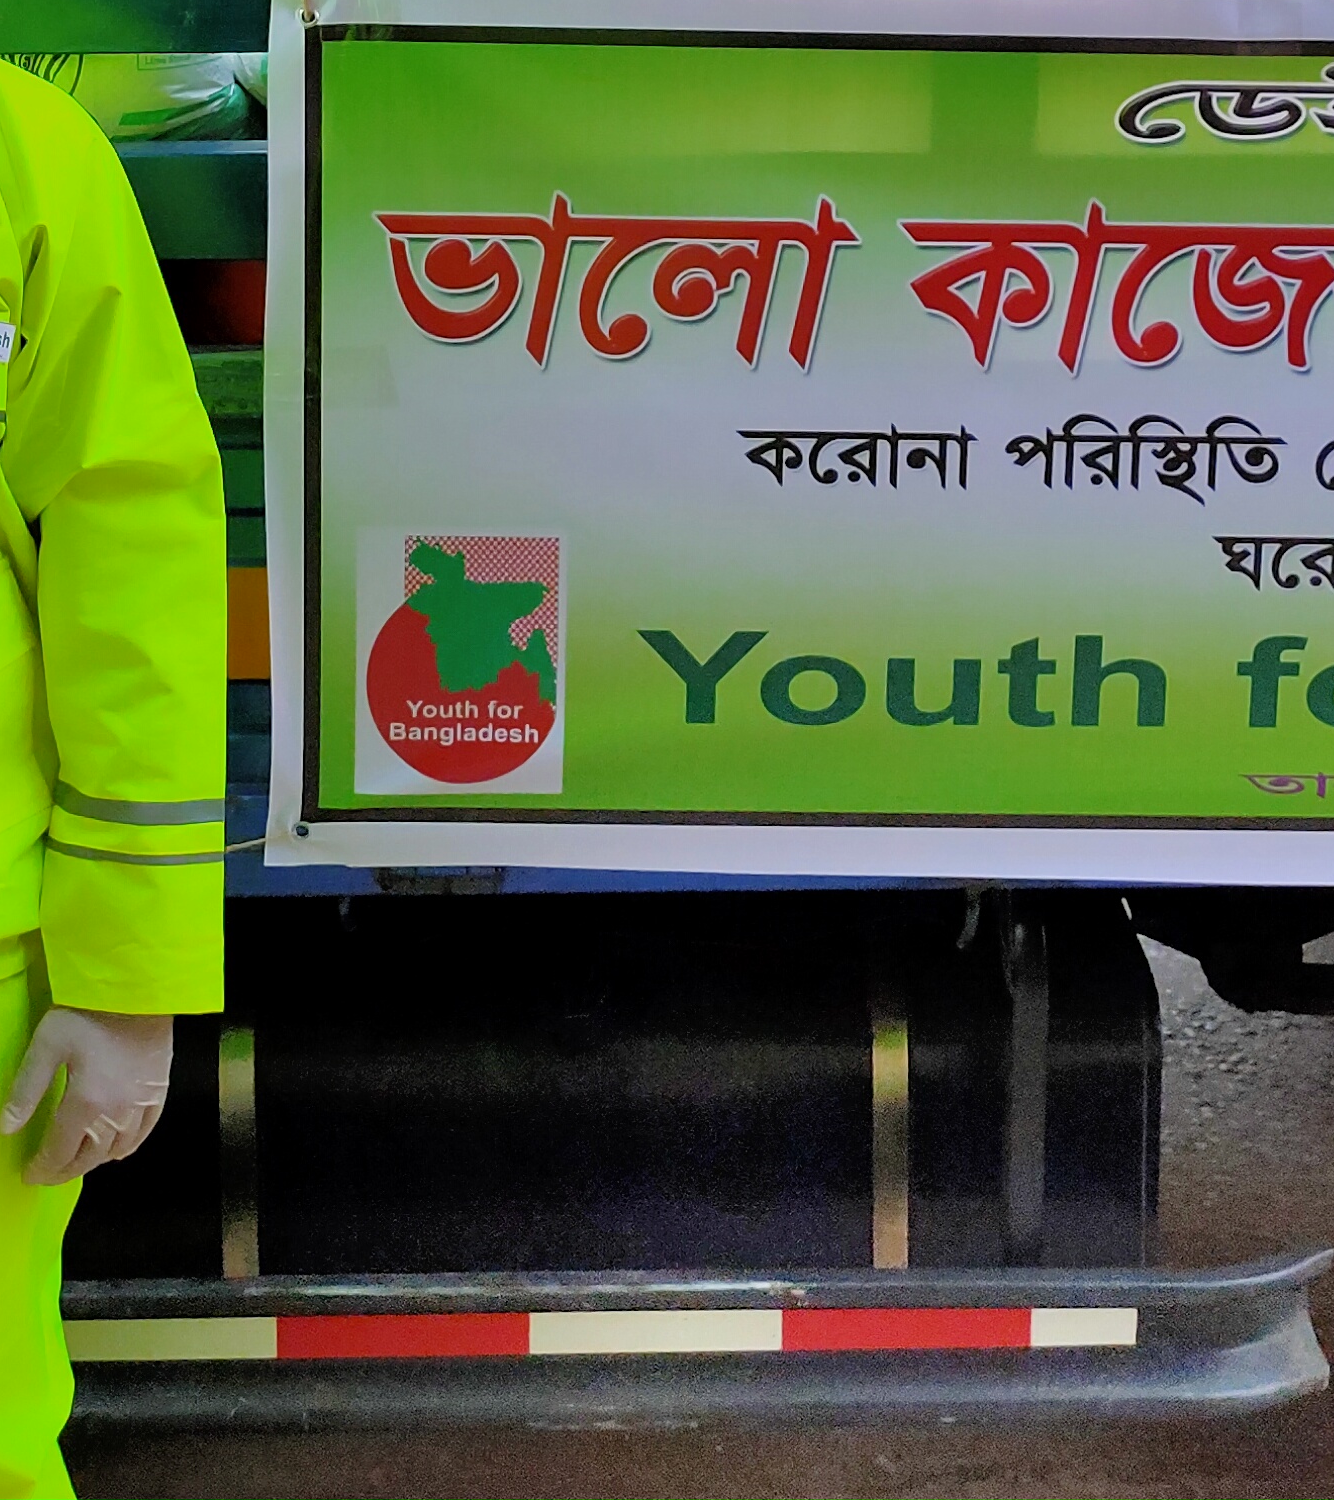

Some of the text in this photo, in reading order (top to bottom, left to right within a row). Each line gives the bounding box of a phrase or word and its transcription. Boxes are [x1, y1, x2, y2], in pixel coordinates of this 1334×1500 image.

[373, 192, 860, 371] ভালো
[736, 424, 978, 490] করোনা
[1004, 414, 1288, 505] পরিস্থিতি
[406, 700, 523, 719] Youth for
[637, 629, 1167, 729] Youth
[389, 722, 539, 746] Bangladesh
